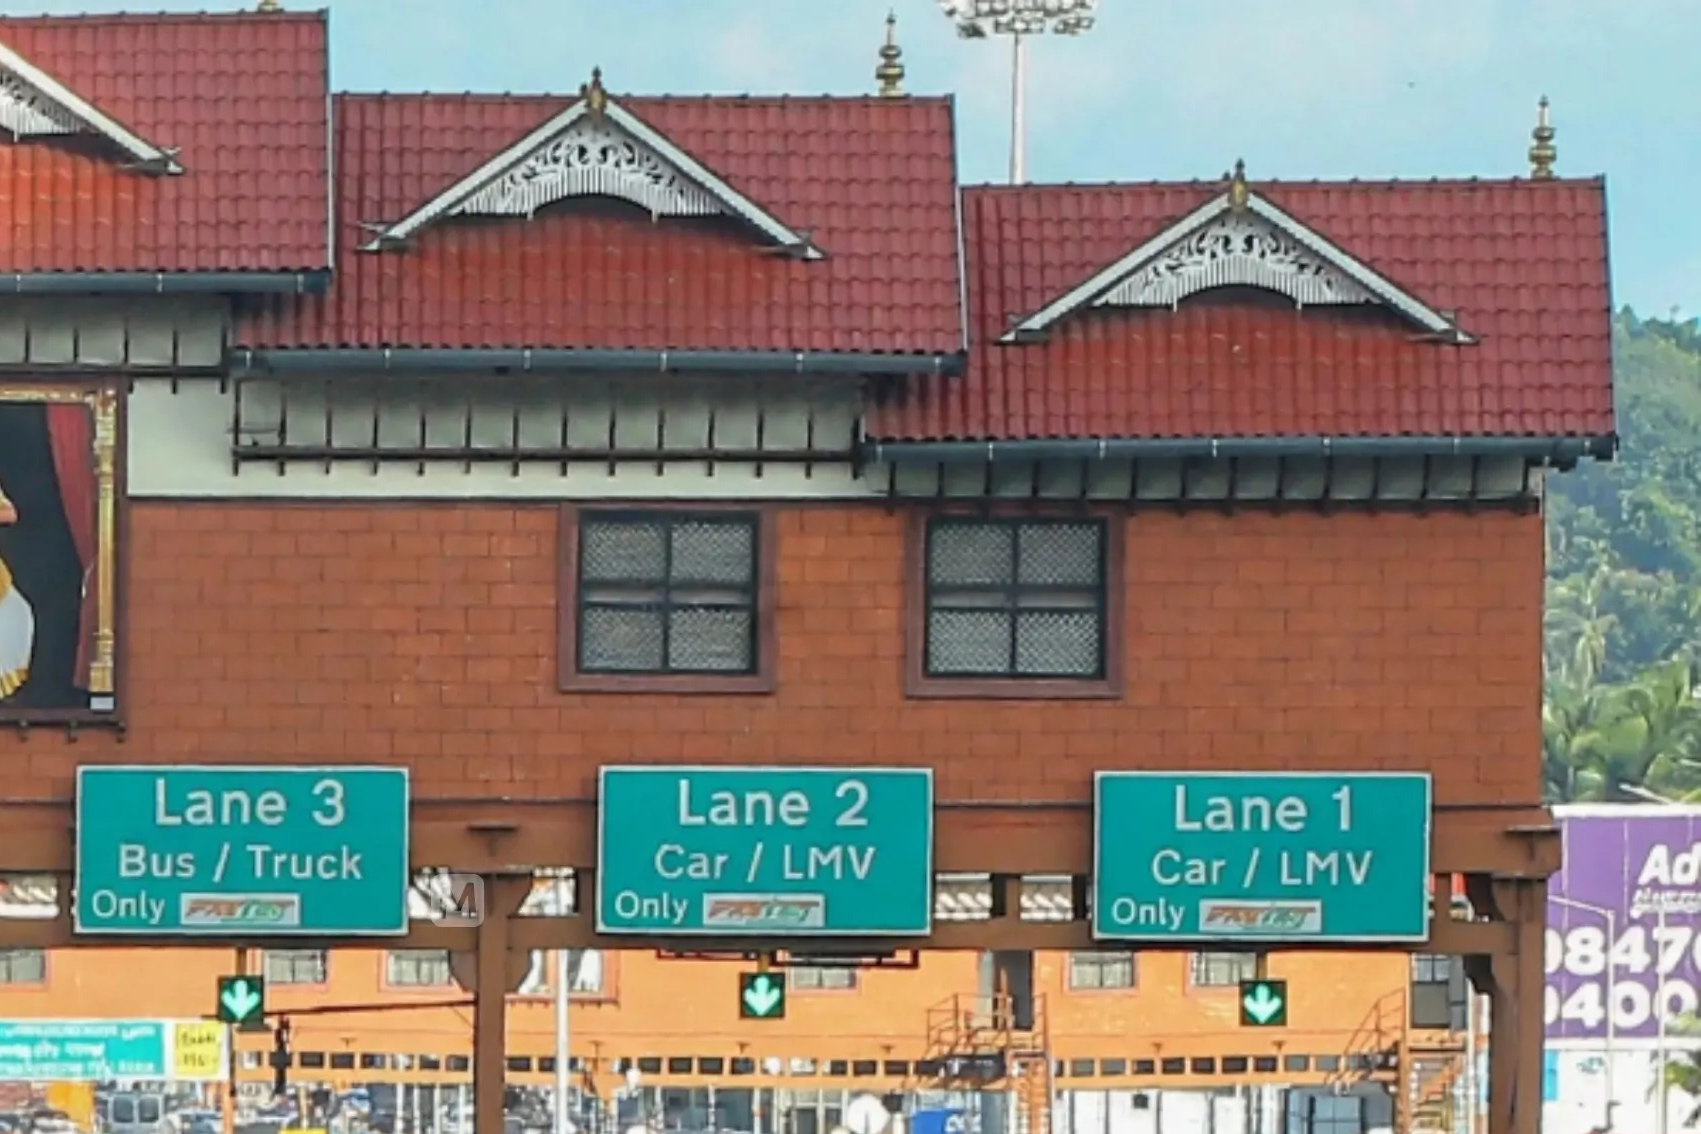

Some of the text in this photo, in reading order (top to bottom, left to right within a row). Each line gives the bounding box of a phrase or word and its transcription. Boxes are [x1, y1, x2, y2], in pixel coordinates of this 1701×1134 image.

[156, 779, 346, 826] Lane 3
[679, 779, 869, 826] Lane 2
[1175, 785, 1351, 831] Lane 1
[119, 845, 363, 881] Bus / Truck
[654, 844, 876, 882] Car / LMV
[1152, 850, 1373, 886] Car / LMV
[91, 890, 165, 925] Only
[614, 891, 688, 924] Only
[1111, 898, 1185, 931] Only
